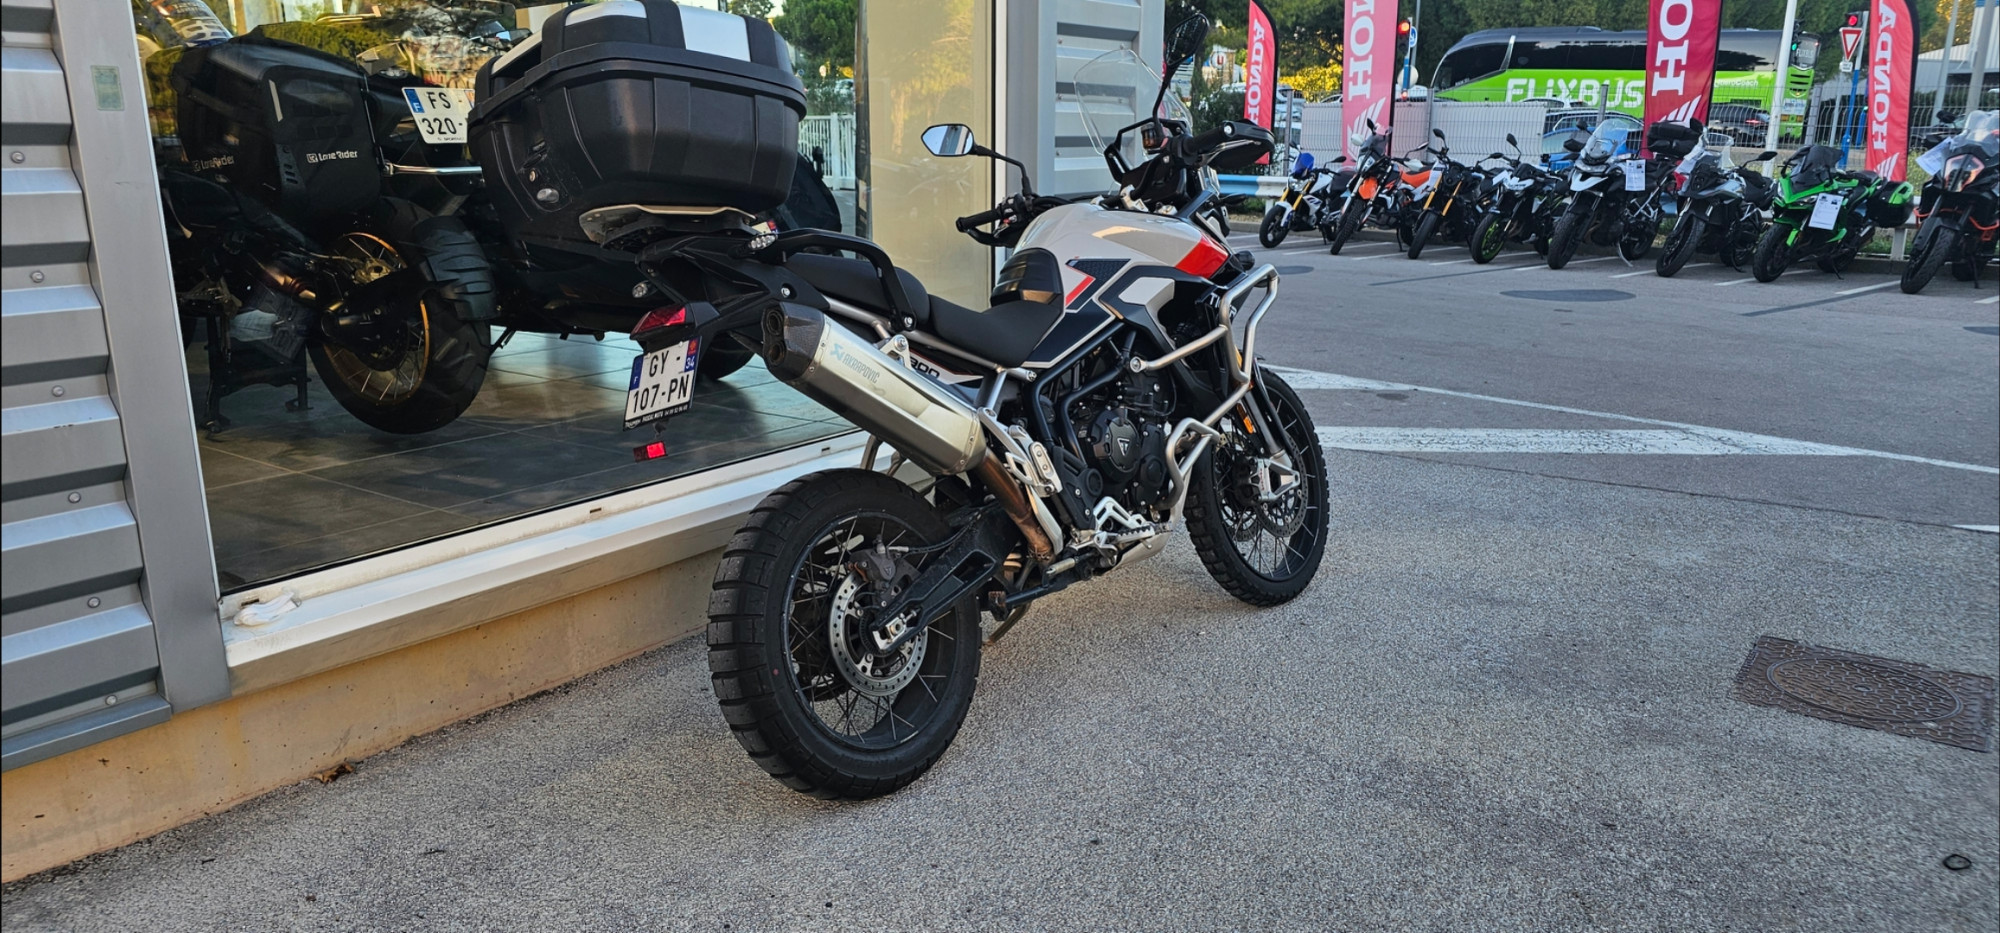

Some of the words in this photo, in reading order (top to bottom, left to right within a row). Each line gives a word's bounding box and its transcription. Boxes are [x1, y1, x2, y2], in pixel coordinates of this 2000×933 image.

[1247, 19, 1265, 126] HONDA
[1872, 0, 1897, 153] HONDA
[426, 91, 451, 109] FS
[1506, 78, 1646, 108] FLIXBUS
[649, 350, 669, 377] GY
[685, 356, 695, 369] 34
[633, 374, 690, 414] 107-PN
